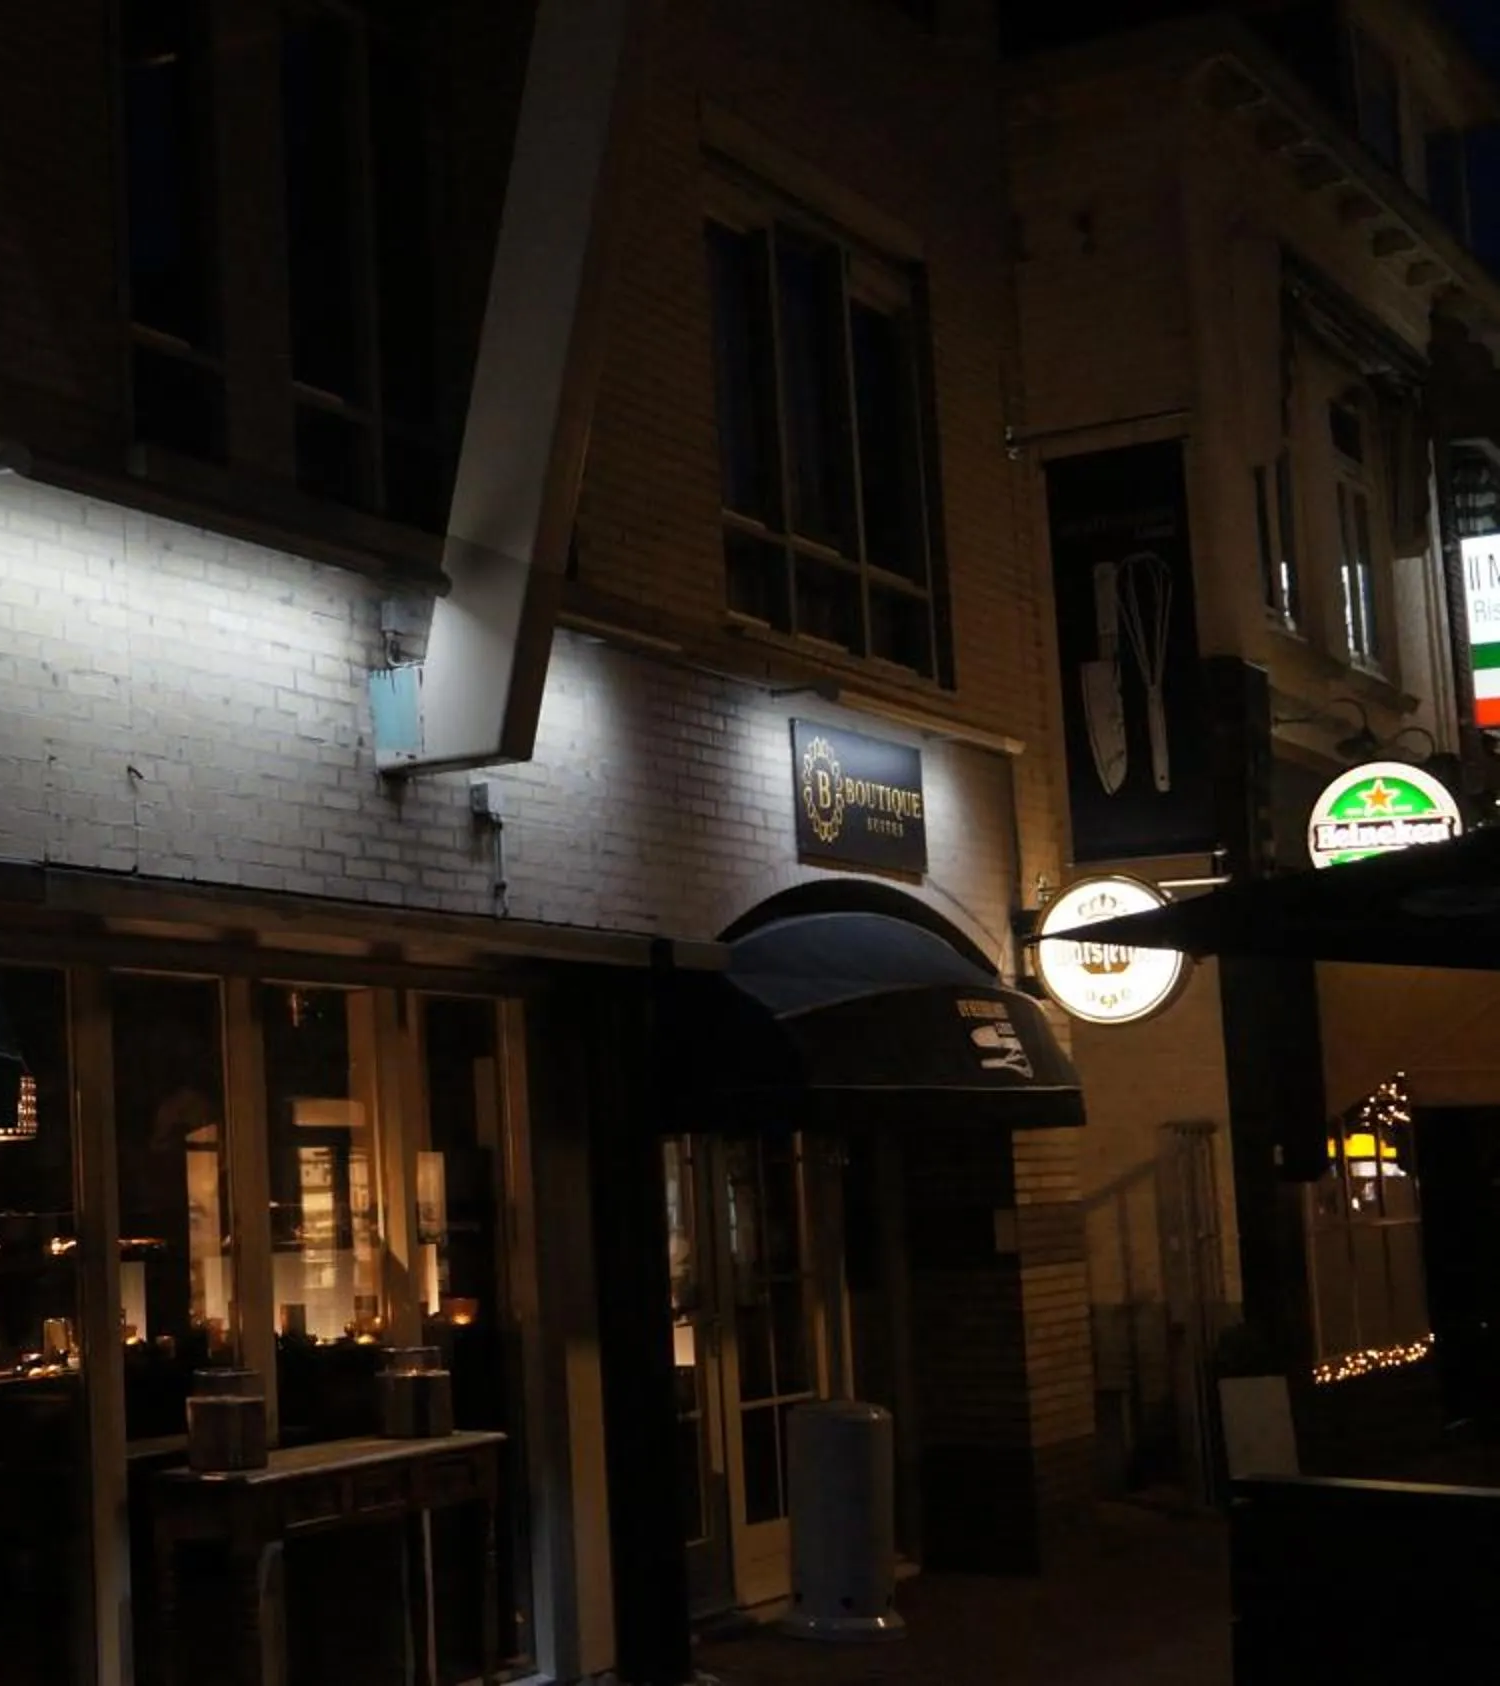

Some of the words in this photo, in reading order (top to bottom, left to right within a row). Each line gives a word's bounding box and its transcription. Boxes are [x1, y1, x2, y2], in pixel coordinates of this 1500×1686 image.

[816, 769, 832, 809] B
[844, 777, 922, 821] BOUTIQUE
[1317, 817, 1449, 849] Heineken
